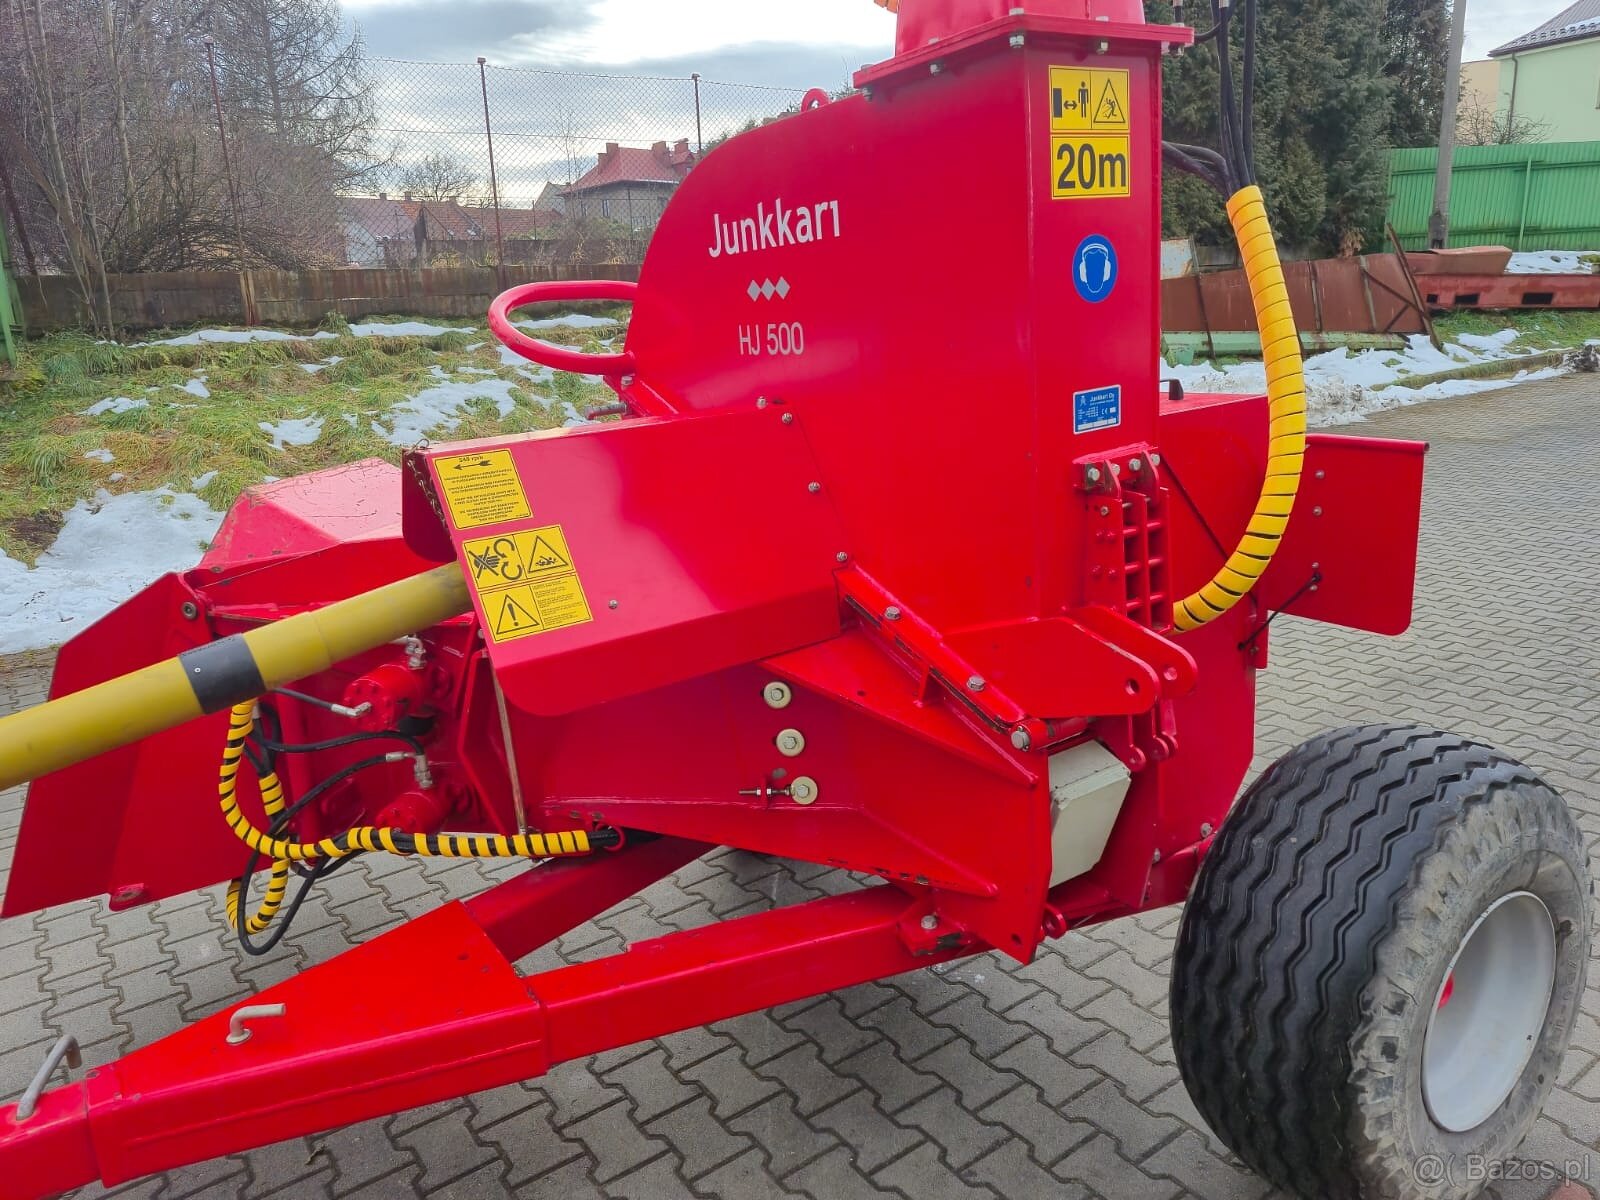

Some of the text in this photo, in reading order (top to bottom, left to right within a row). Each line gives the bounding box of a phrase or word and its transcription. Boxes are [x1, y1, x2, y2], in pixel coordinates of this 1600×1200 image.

[1057, 143, 1127, 190] 20m
[738, 321, 804, 356] HJ 500
